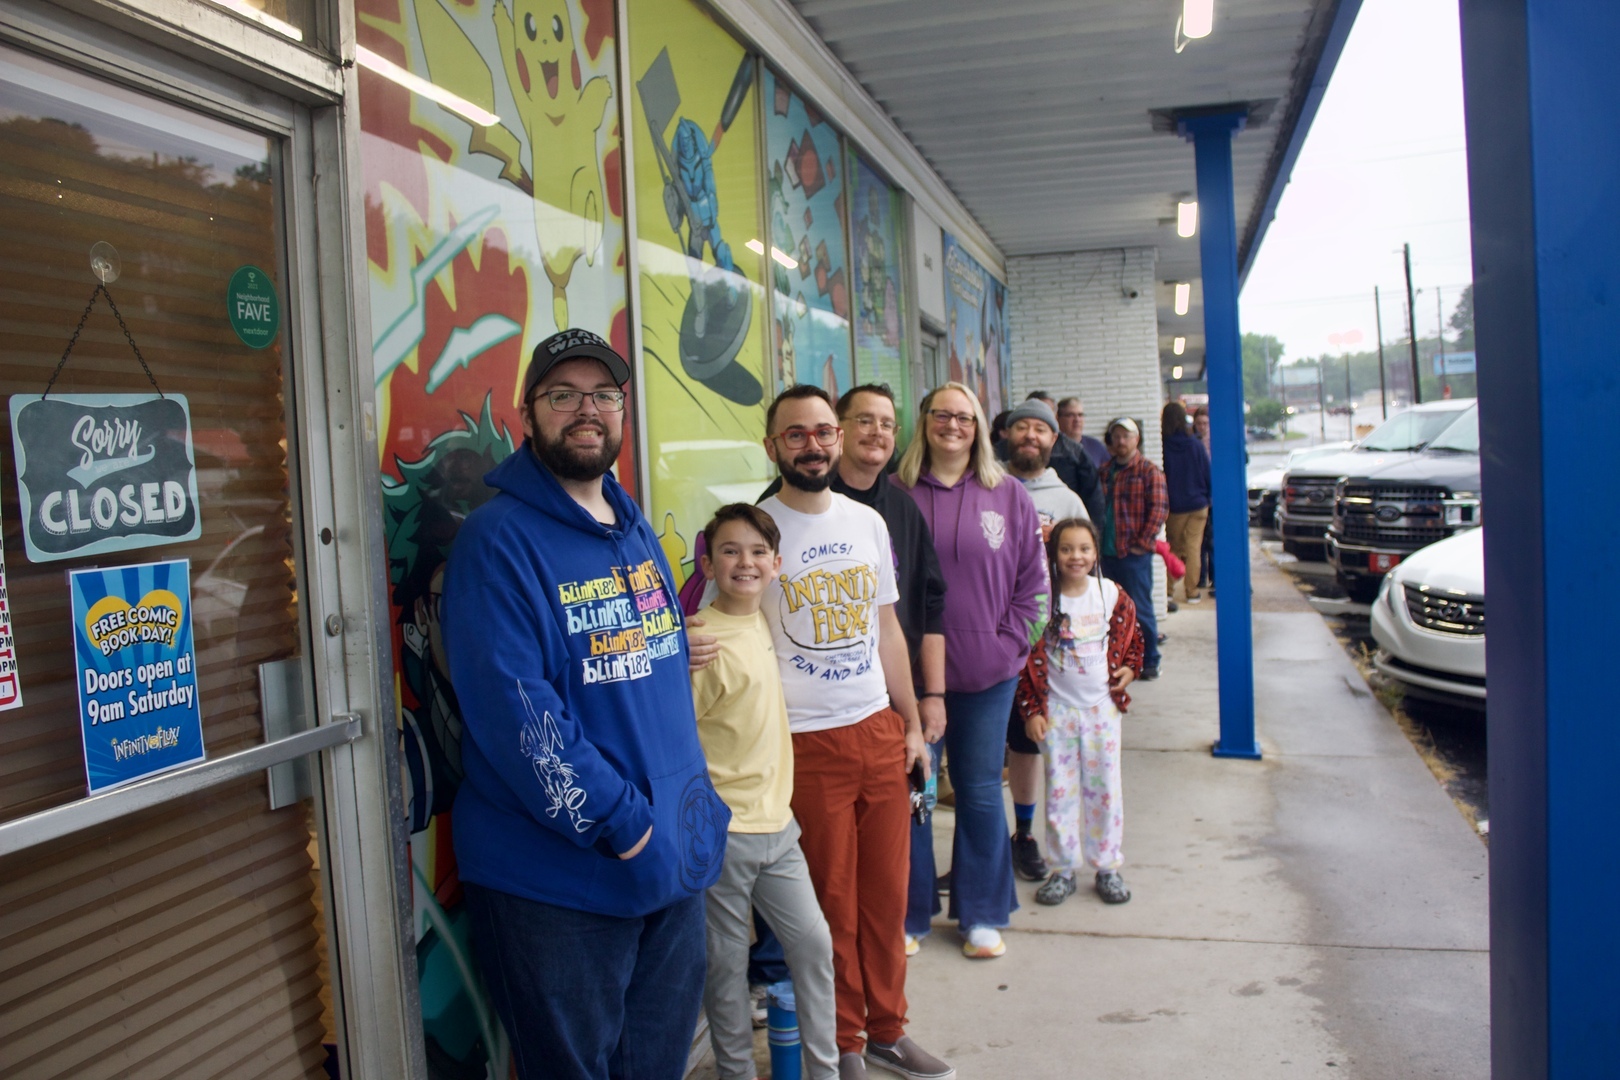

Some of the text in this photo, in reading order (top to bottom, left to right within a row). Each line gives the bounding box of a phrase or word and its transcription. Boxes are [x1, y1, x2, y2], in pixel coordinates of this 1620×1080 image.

[236, 292, 270, 303] Neighborhood
[237, 302, 271, 322] FAVE
[243, 328, 269, 336] nextdoor
[548, 330, 608, 348] STAR
[549, 338, 599, 354] WAR
[71, 415, 142, 471] Sorry
[39, 481, 187, 535] CLOSED
[801, 543, 853, 564] COMICS!
[91, 606, 178, 640] FREE COMIC
[811, 601, 873, 645] FLUX!
[100, 625, 173, 656] BOOK DAY!
[0, 659, 17, 673] PM
[85, 652, 191, 694] Doors open at
[789, 655, 818, 676] FUN
[820, 668, 851, 681] AND
[87, 680, 194, 725] 9am Saturday
